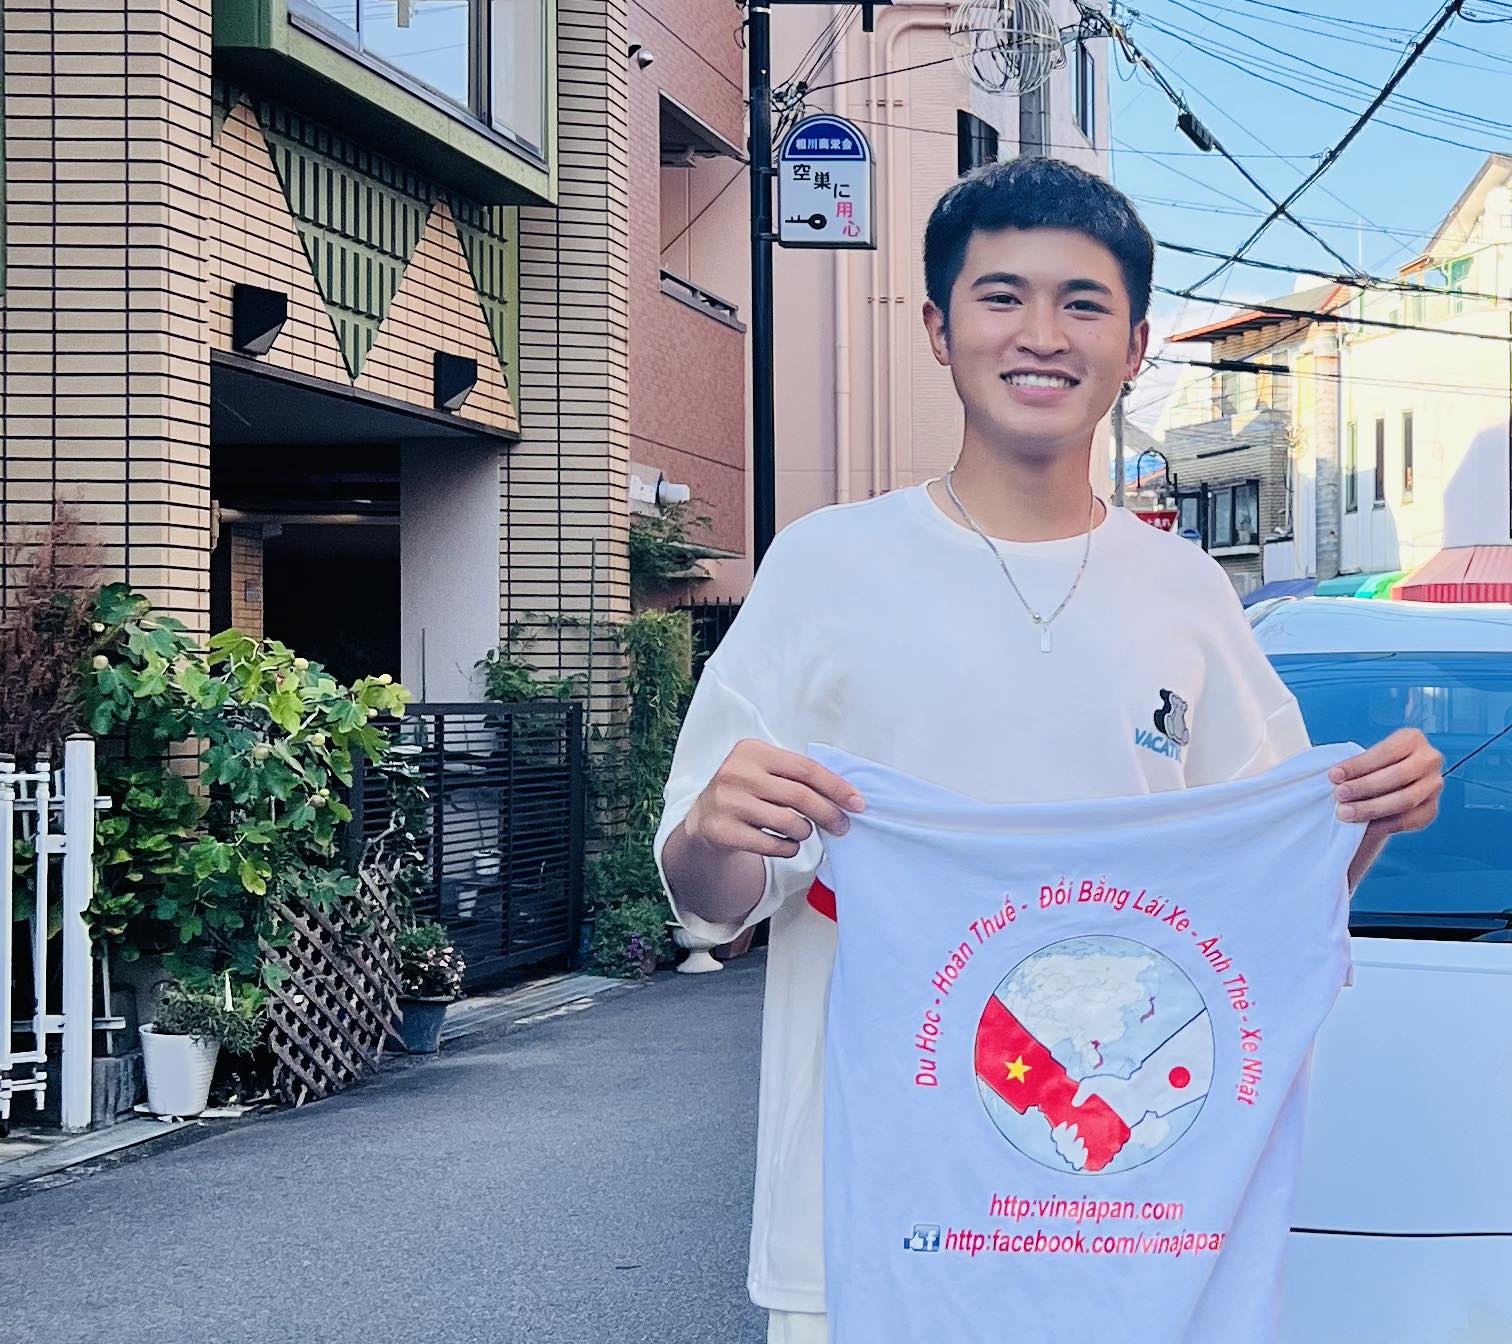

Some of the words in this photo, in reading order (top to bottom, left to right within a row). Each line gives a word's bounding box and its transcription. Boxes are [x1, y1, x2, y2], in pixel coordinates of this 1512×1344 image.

[793, 163, 861, 238] 空巣に用心
[1039, 876, 1073, 910] Đổi
[1078, 874, 1131, 912] Bằng
[1133, 889, 1169, 917] Lái
[969, 895, 1017, 945] Thuế
[1162, 905, 1191, 933] Xe
[931, 941, 974, 996] Hoàn
[914, 1010, 943, 1053] Học
[1239, 1026, 1263, 1053] Xe
[1235, 1058, 1264, 1106] Nhật
[988, 1193, 1184, 1223] http:vinajapan.com
